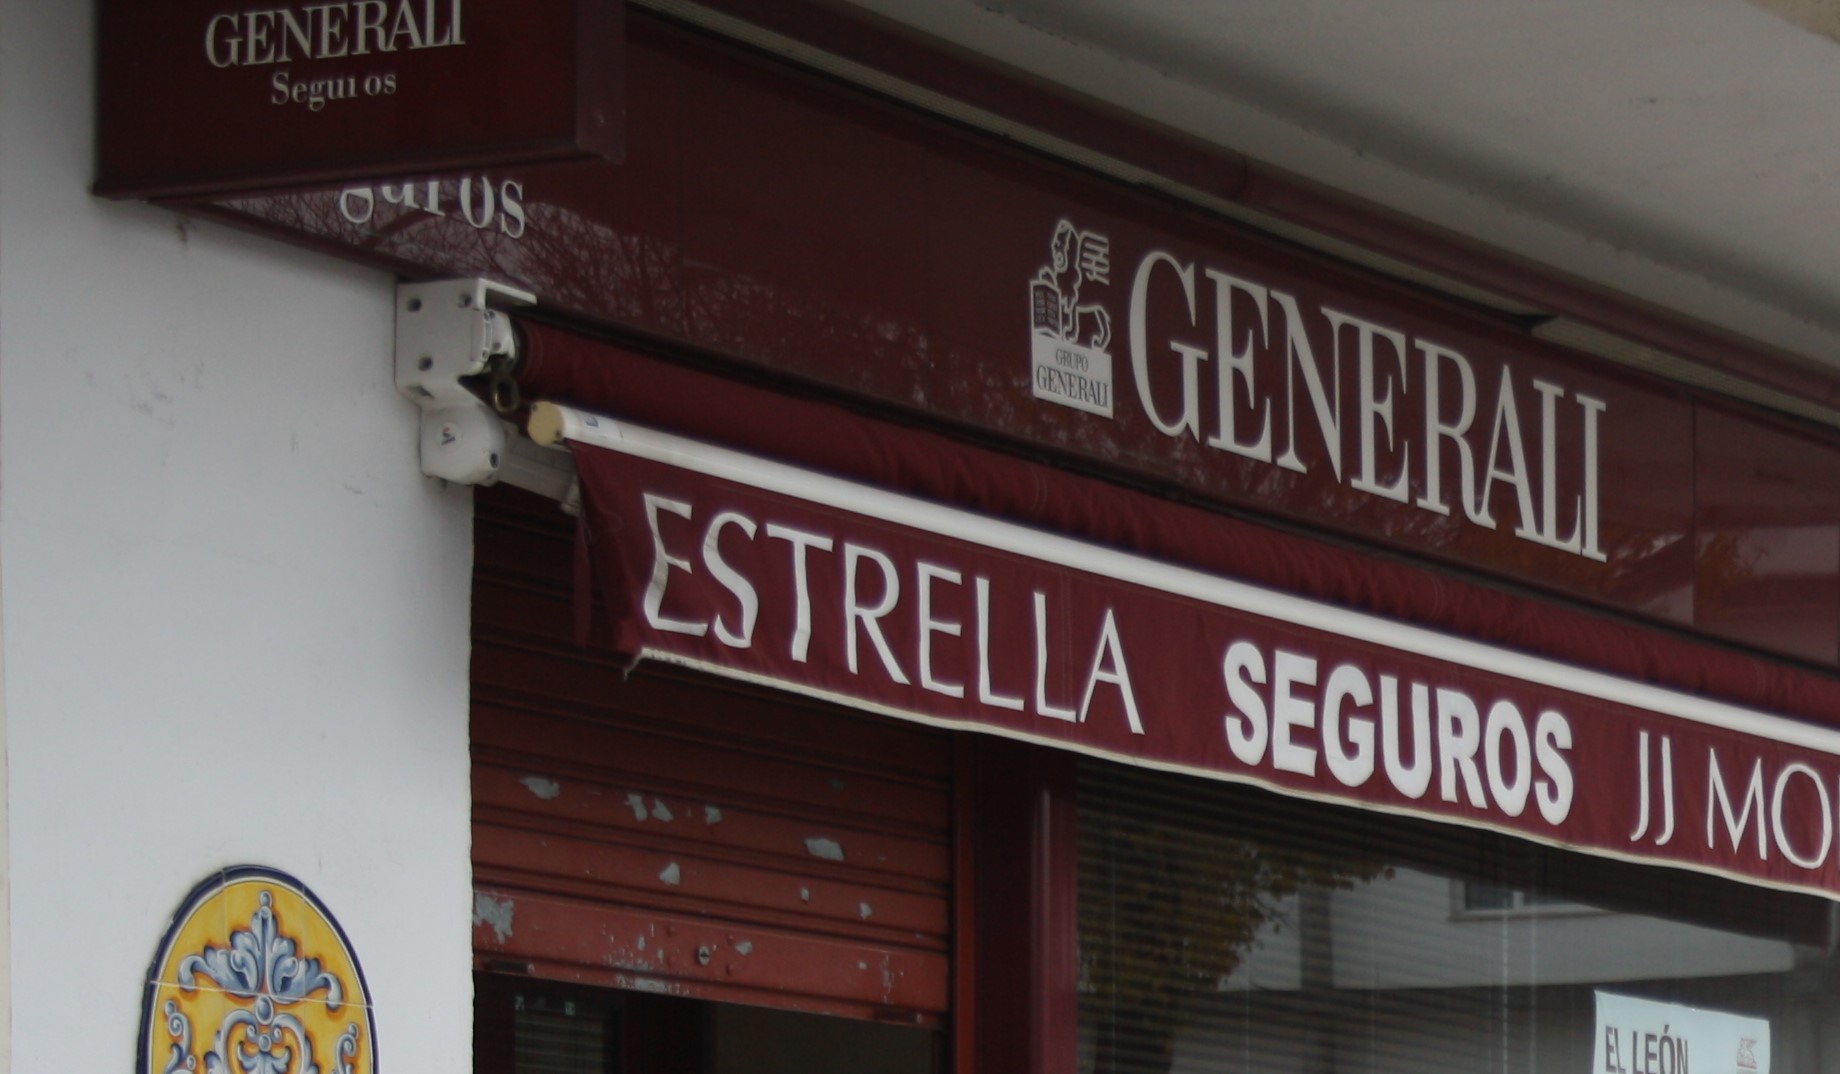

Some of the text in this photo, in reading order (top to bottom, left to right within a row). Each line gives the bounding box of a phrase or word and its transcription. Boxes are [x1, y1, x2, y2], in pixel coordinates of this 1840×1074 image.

[205, 0, 466, 68] GENERALI
[1037, 365, 1109, 408] GENERALI
[1056, 348, 1089, 373] GRUPO
[1129, 250, 1607, 563] GENERALI
[643, 492, 1145, 735] ESTRELLA
[1223, 641, 1574, 827] SEGUROS
[1630, 731, 1674, 846] JJ
[1605, 1024, 1689, 1074] EL LEÓN
